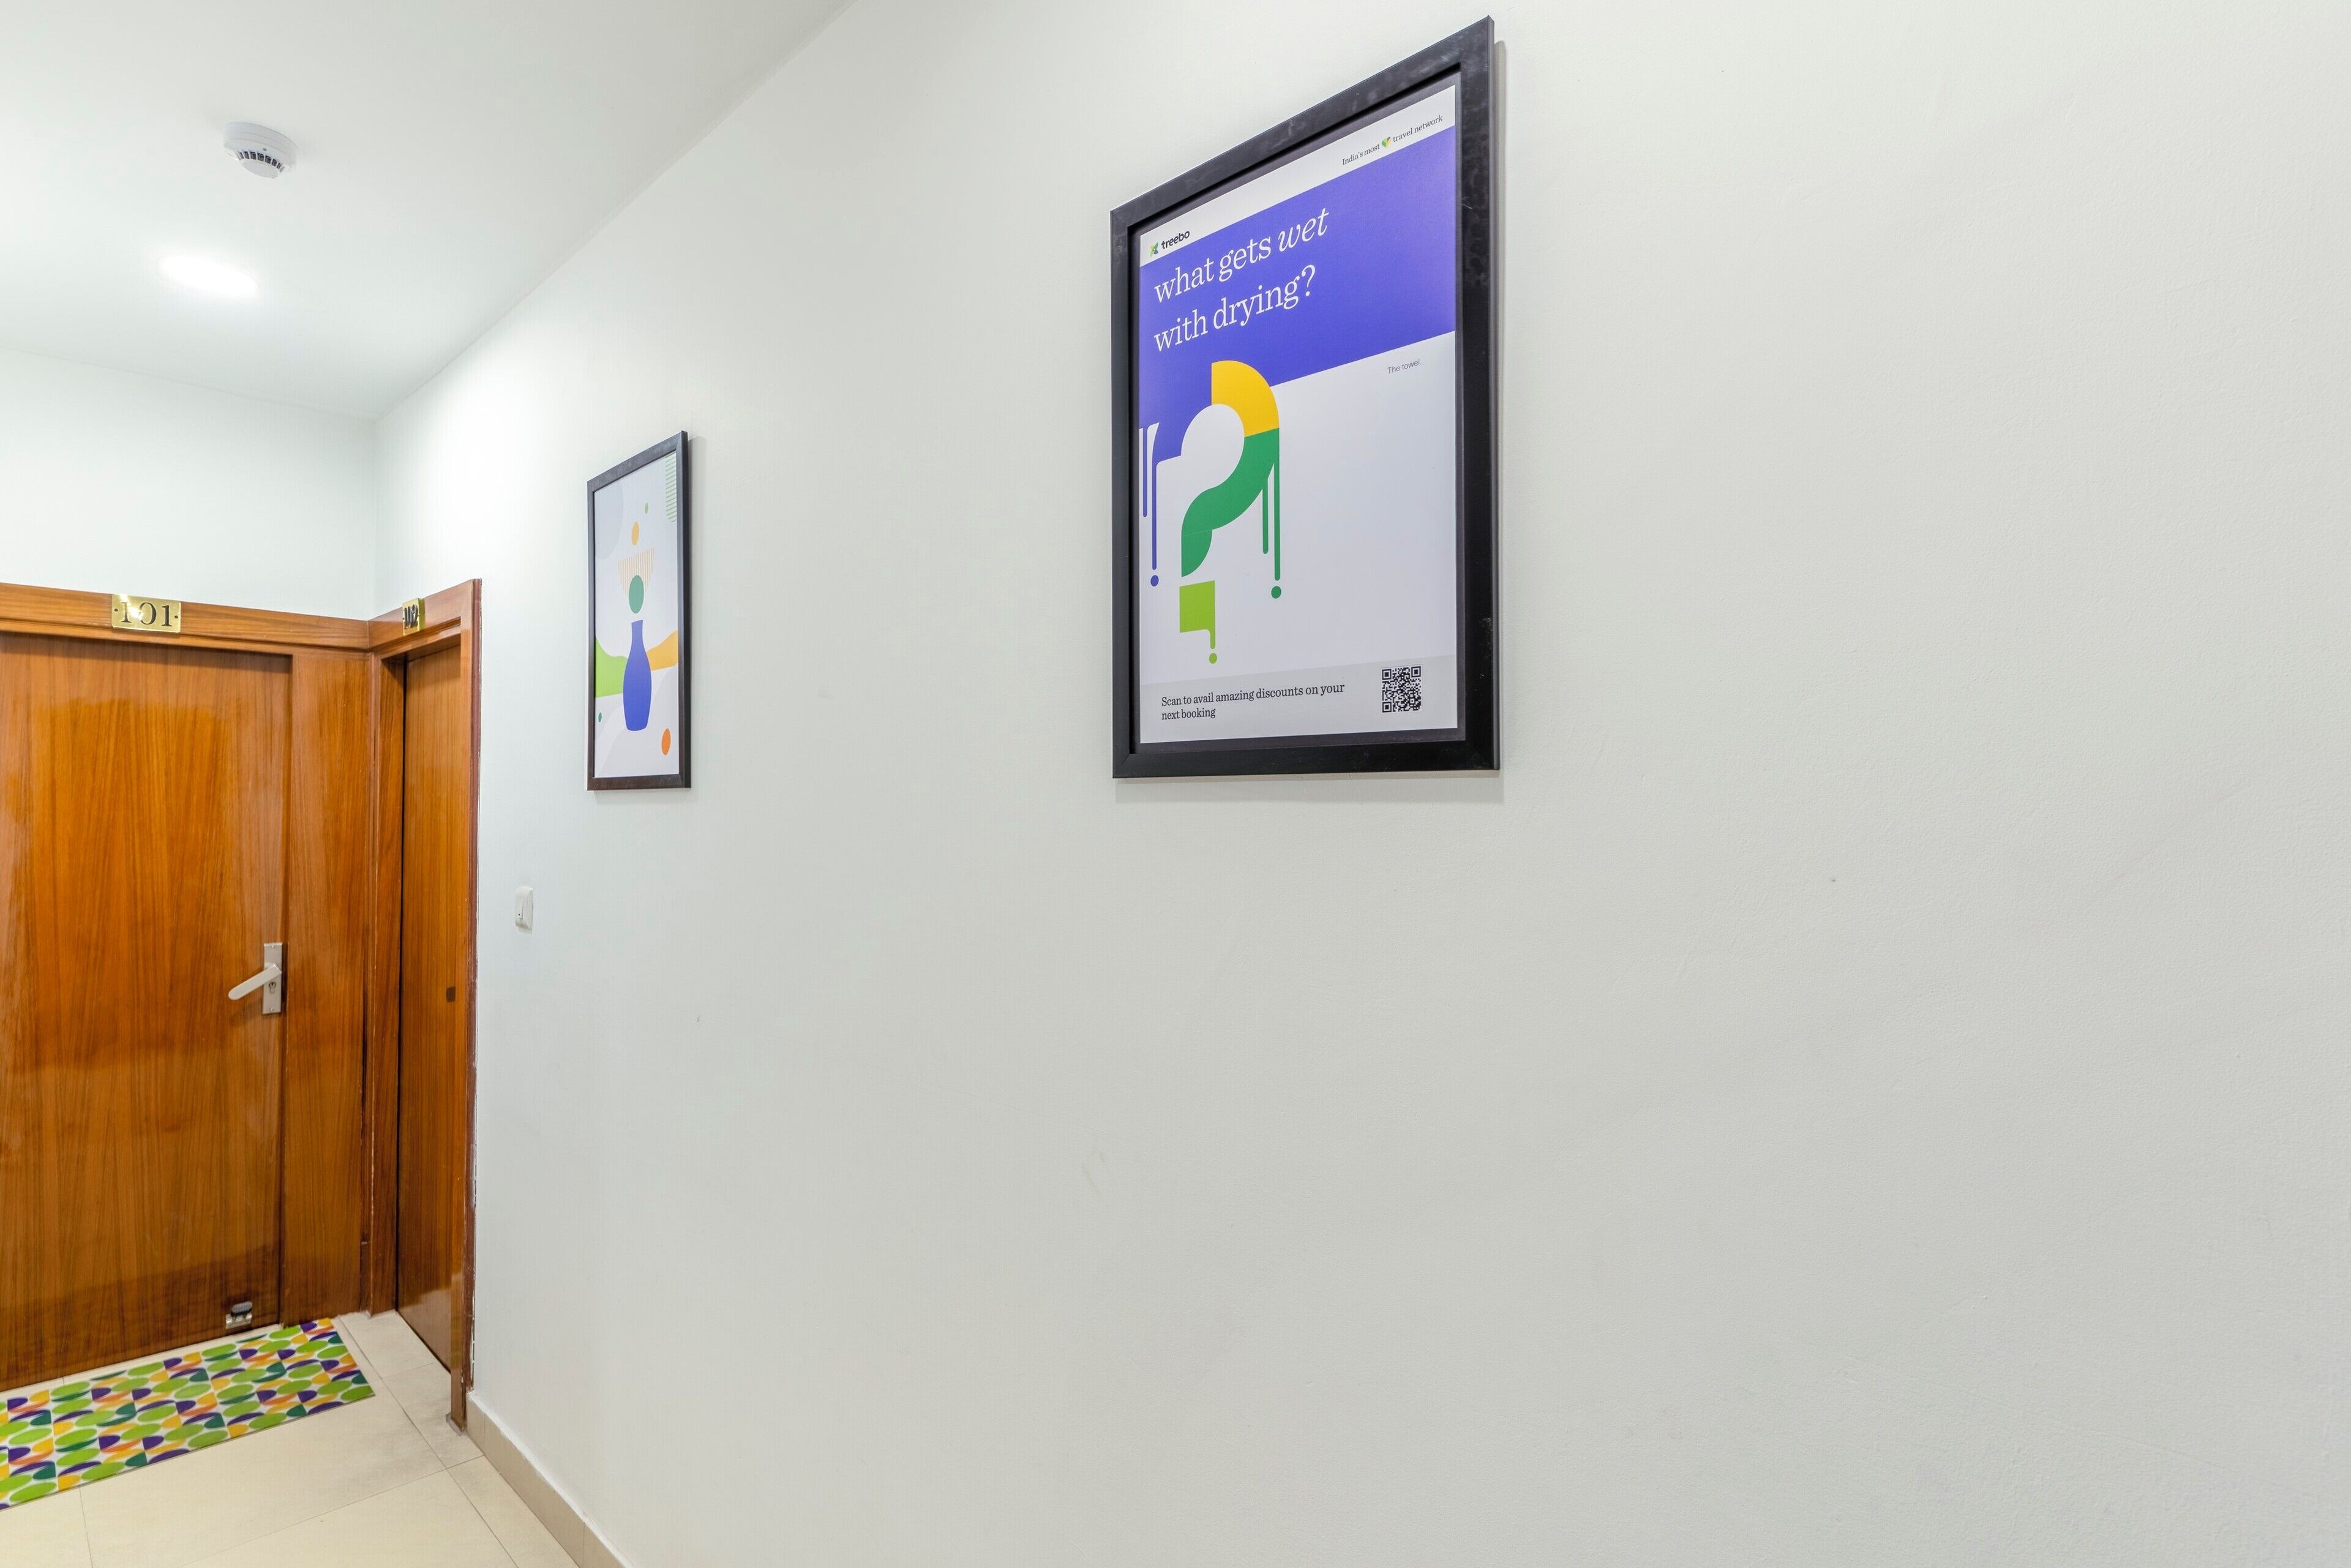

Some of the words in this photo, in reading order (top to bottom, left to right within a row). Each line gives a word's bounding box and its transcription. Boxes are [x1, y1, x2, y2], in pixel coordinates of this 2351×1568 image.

[1341, 151, 1363, 165] India's
[1364, 144, 1381, 156] most
[1393, 127, 1413, 143] travel
[1414, 114, 1444, 133] network
[1161, 230, 1190, 249] treebo
[1154, 257, 1215, 303] what
[1218, 236, 1272, 282] gets
[1278, 207, 1329, 252] wet
[1153, 309, 1209, 352] with
[1213, 264, 1316, 327] drying?
[1387, 366, 1400, 374] The
[121, 601, 173, 627] 101
[1161, 697, 1182, 707] Scan
[1183, 696, 1192, 705] to
[1193, 692, 1214, 703] avail
[1215, 690, 1254, 702] amazing
[1256, 687, 1303, 699] discounts
[1305, 686, 1319, 695] on
[1320, 685, 1345, 696] your
[1161, 710, 1180, 720] next
[1181, 708, 1216, 719] booking
